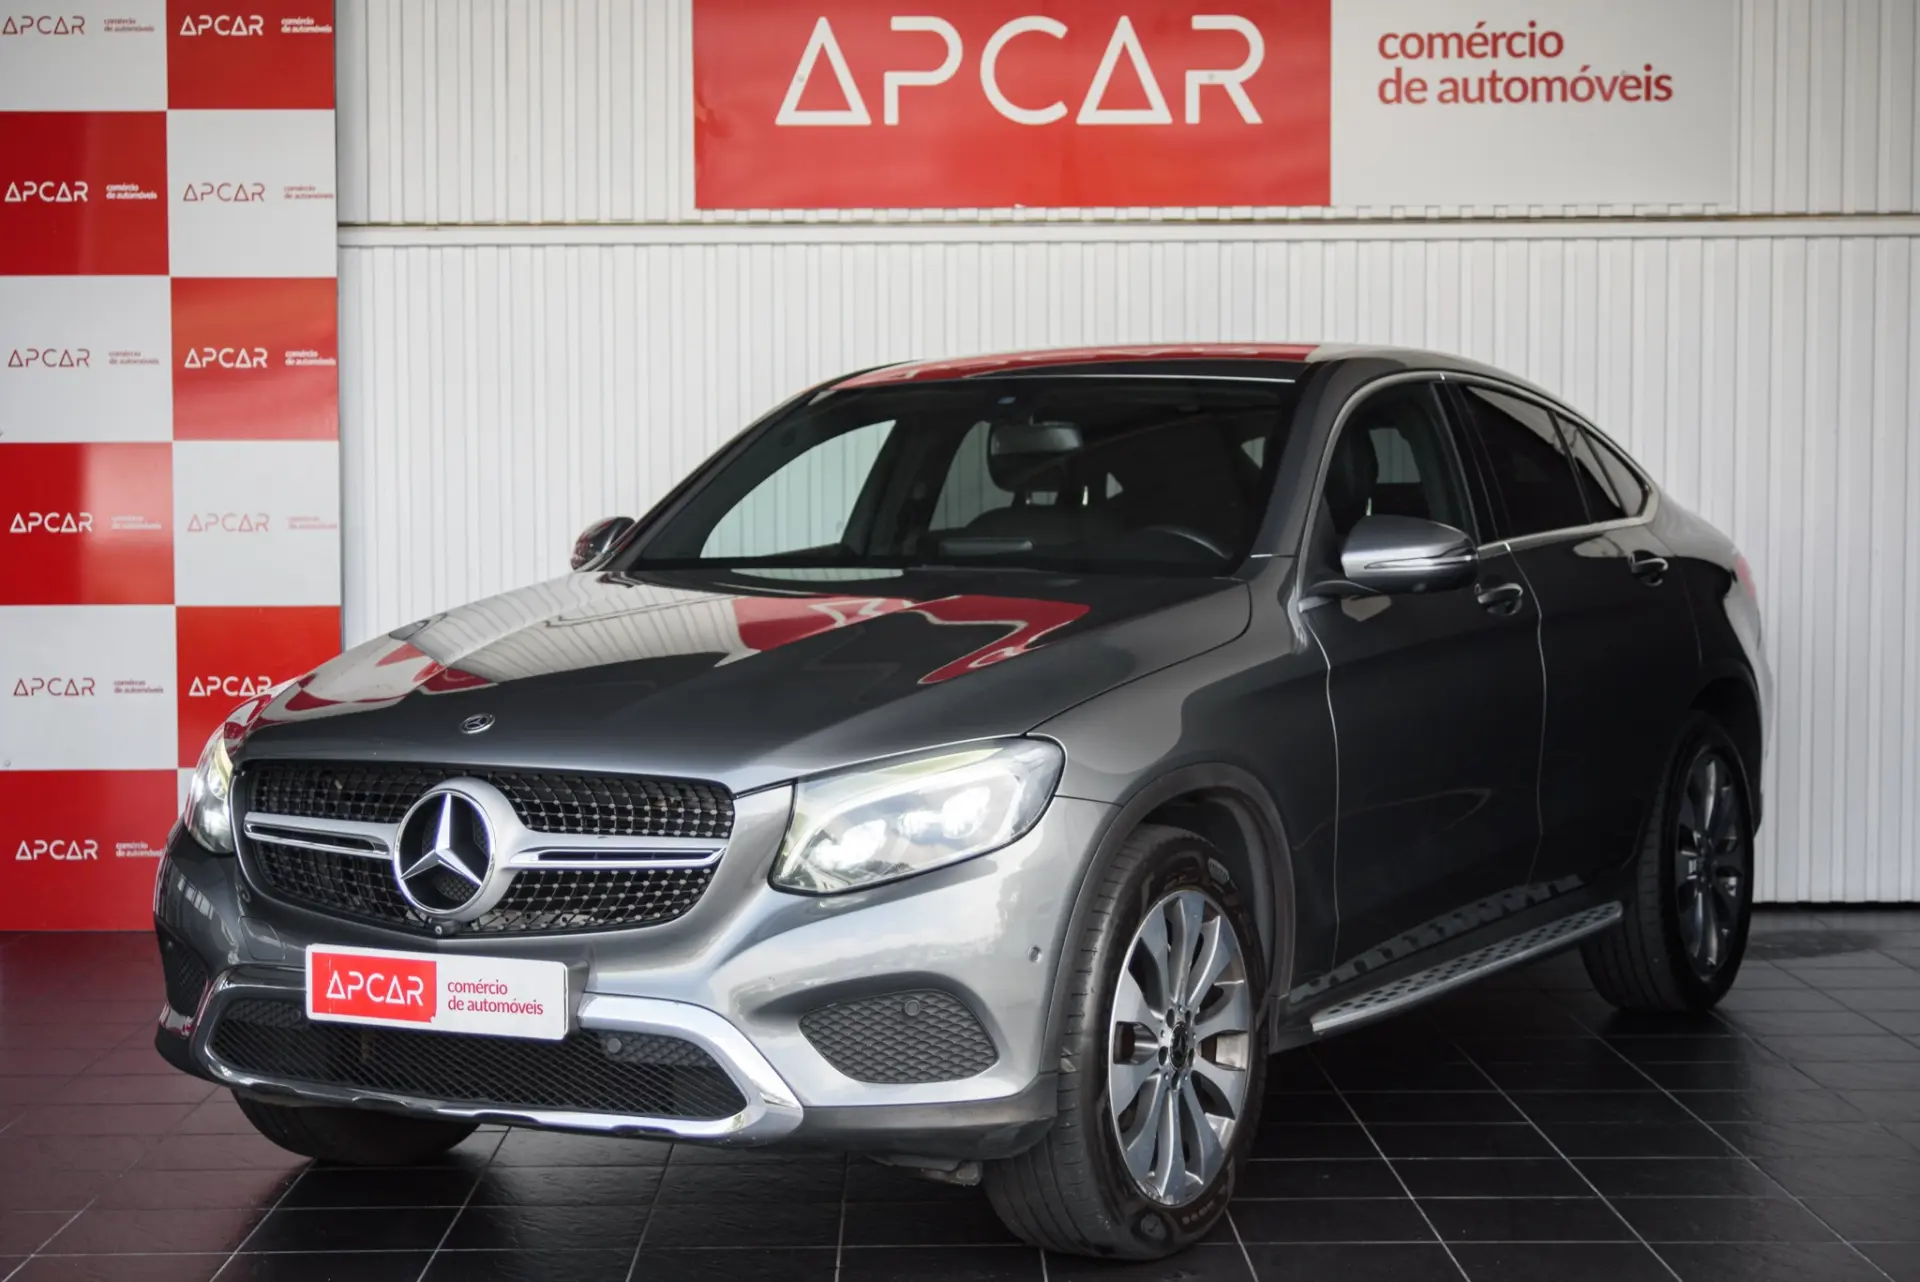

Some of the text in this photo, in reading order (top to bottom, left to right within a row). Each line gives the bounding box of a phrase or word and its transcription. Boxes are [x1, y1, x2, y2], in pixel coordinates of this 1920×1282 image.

[2, 15, 86, 35] APCAR
[180, 14, 264, 36] APCAR
[1378, 20, 1564, 59] comércio
[775, 15, 1266, 126] APCAR
[1378, 63, 1673, 104] de automóveis
[5, 181, 89, 202] APCAR
[183, 182, 265, 202] APCAR
[8, 348, 90, 368] APCAR
[184, 347, 268, 368] APCAR
[9, 512, 93, 533] APCAR
[187, 512, 270, 532] APCAR
[13, 677, 96, 696] APCAR
[15, 839, 98, 861] APCAR
[326, 969, 424, 1007] APCAR
[447, 979, 508, 996] comércio
[448, 996, 544, 1016] de automóveis
